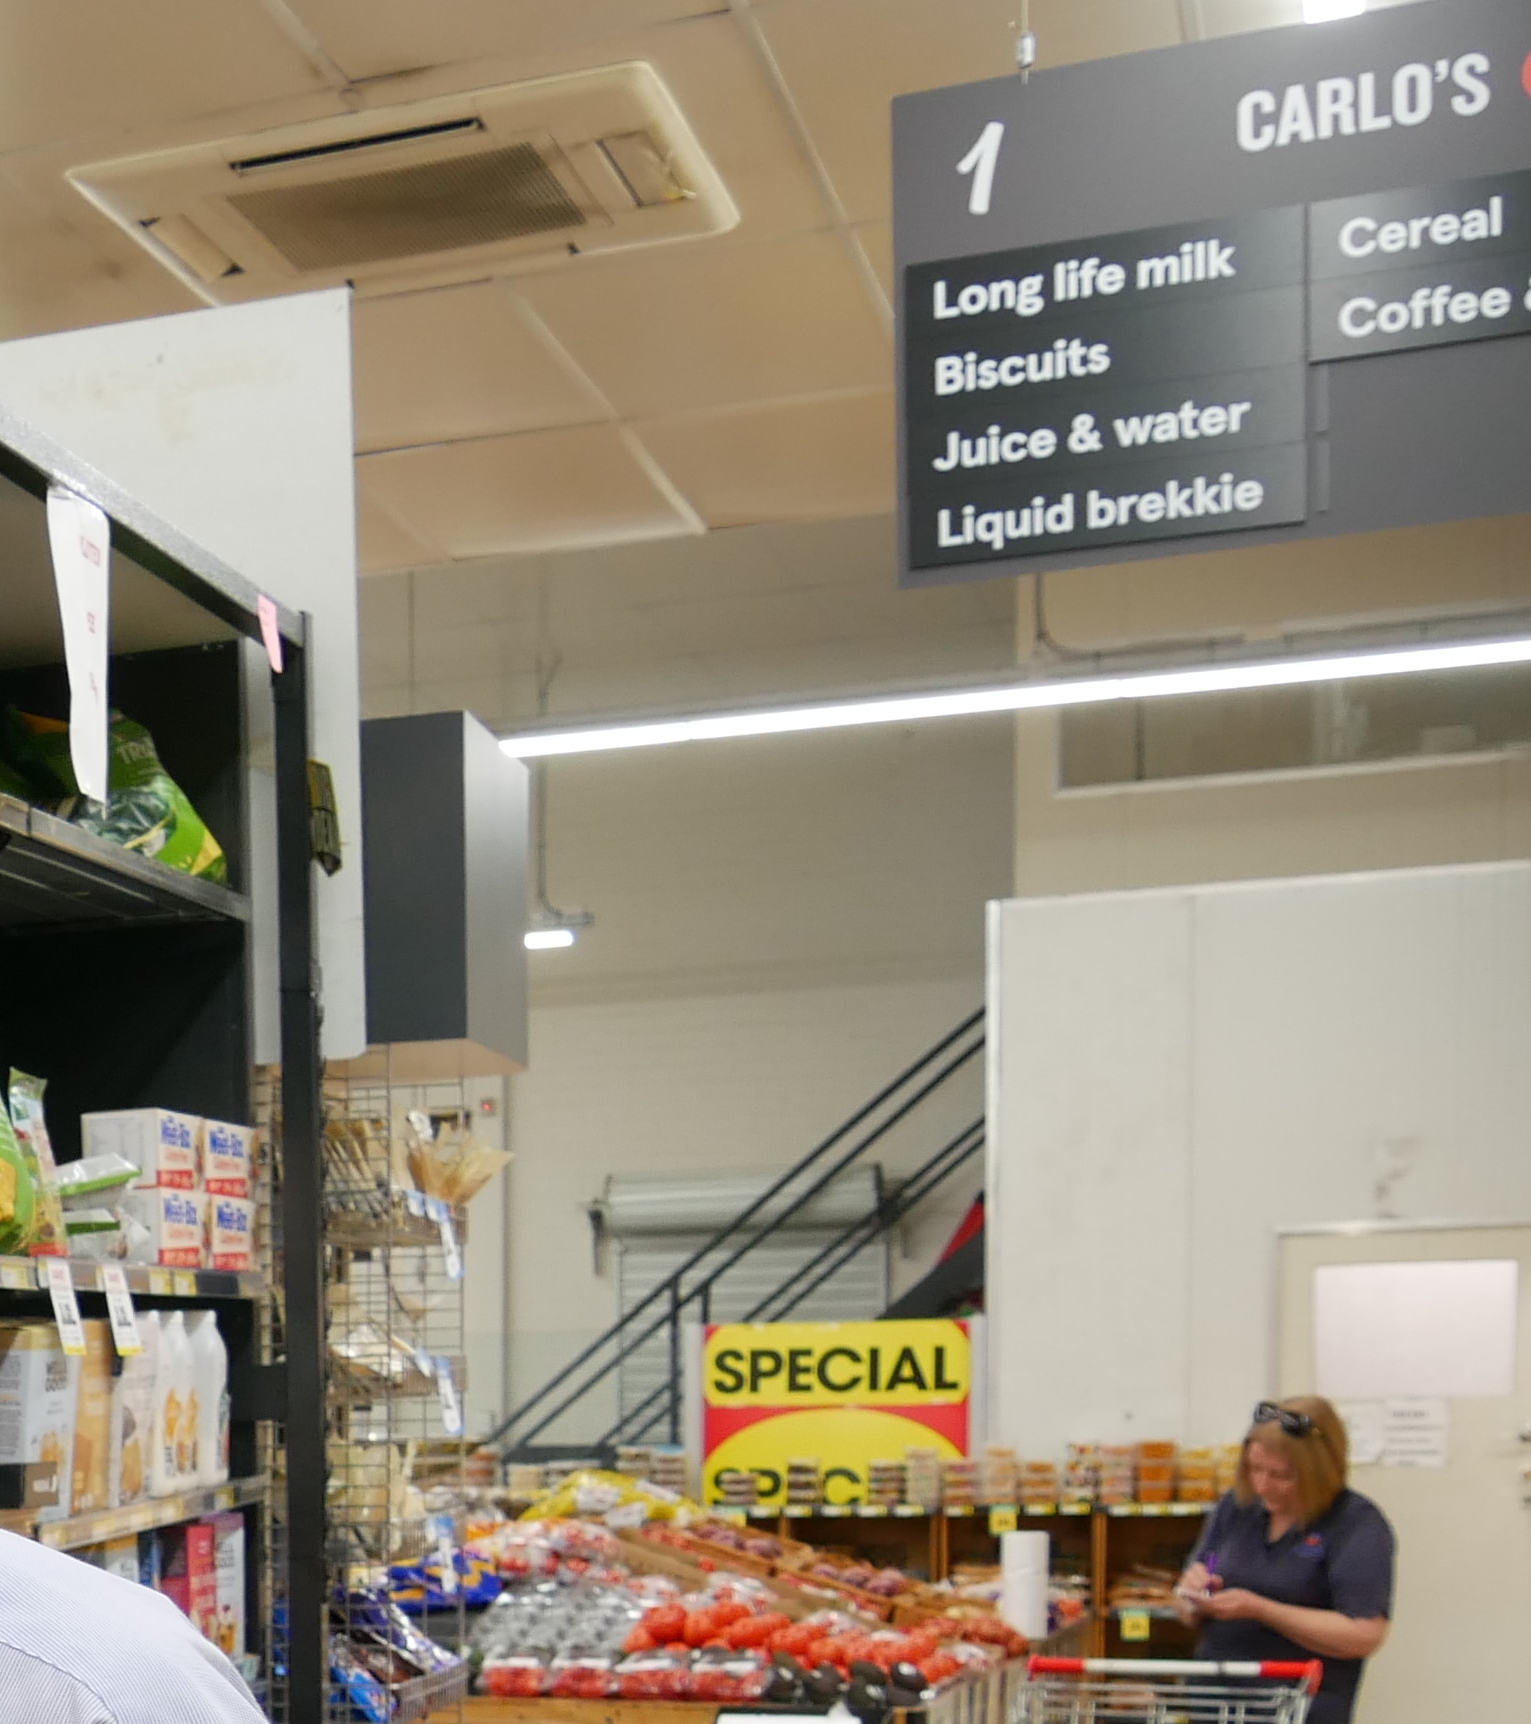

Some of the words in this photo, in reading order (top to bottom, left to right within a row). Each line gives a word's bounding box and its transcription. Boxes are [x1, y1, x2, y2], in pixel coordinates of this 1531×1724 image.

[1237, 53, 1490, 152] CARLO'S
[956, 121, 1003, 215] 1
[1340, 196, 1503, 256] Cereal
[933, 274, 1044, 319] Long
[1054, 258, 1125, 302] life
[1137, 239, 1236, 288] milk
[1338, 284, 1511, 337] Coffee
[934, 339, 1110, 396] Biscuits
[933, 425, 1056, 471] Juice
[1067, 414, 1103, 453] &
[1114, 399, 1251, 446] water
[937, 492, 1074, 549] Liquid
[1086, 475, 1264, 530] brekkie
[714, 1346, 958, 1393] SPECIAL
